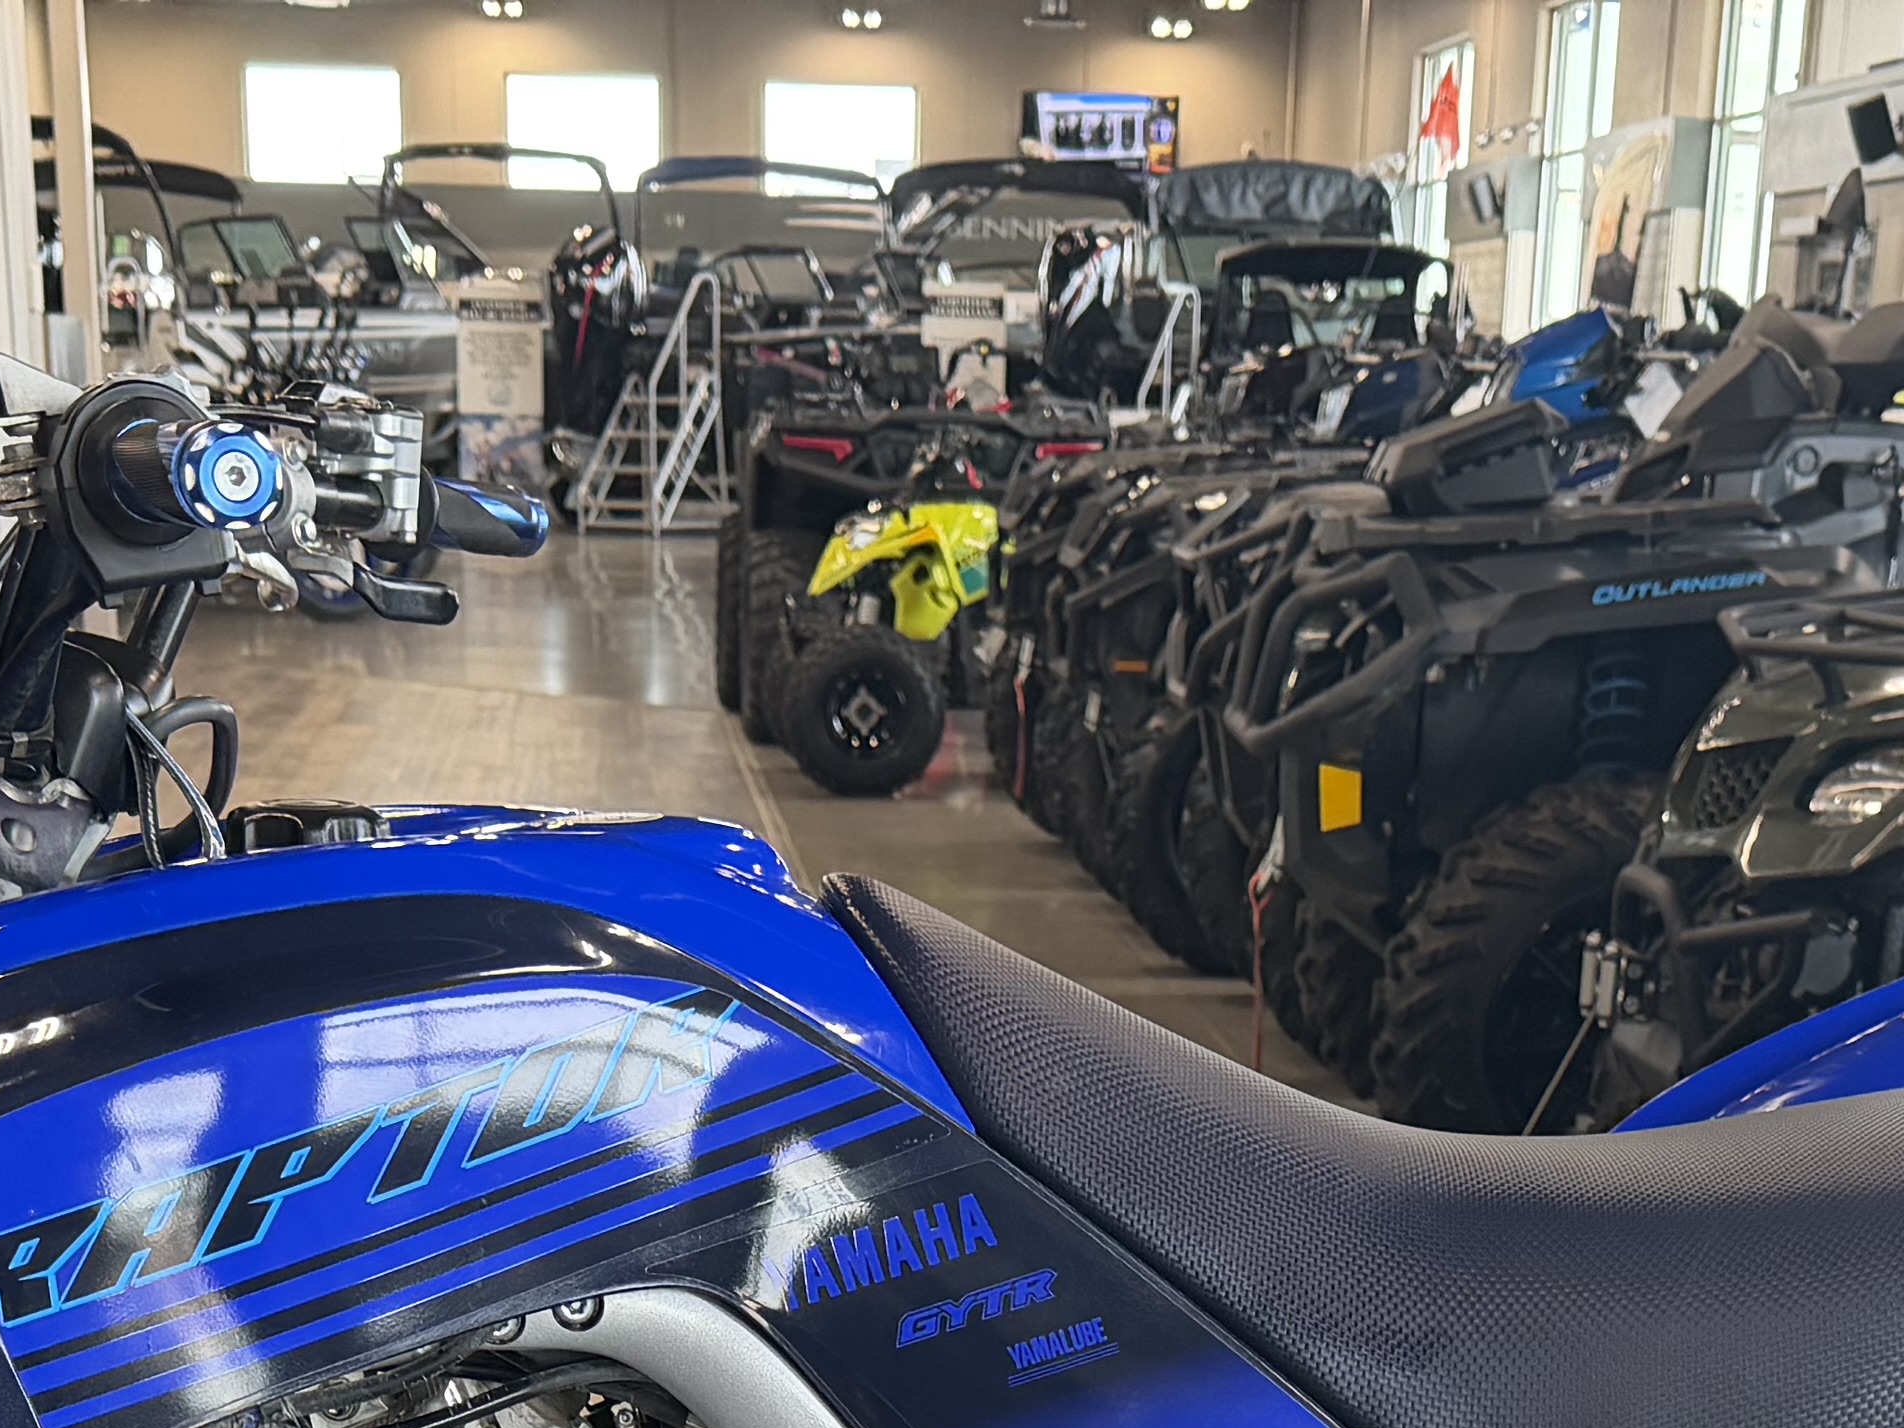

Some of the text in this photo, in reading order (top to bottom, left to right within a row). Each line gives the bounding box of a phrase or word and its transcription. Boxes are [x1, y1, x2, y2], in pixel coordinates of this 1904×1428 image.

[1590, 569, 1767, 606] OUTLANDER
[763, 1192, 997, 1312] YAMAHA
[896, 1268, 1060, 1349] GYTR
[1006, 1316, 1108, 1371] YAMALUBE
